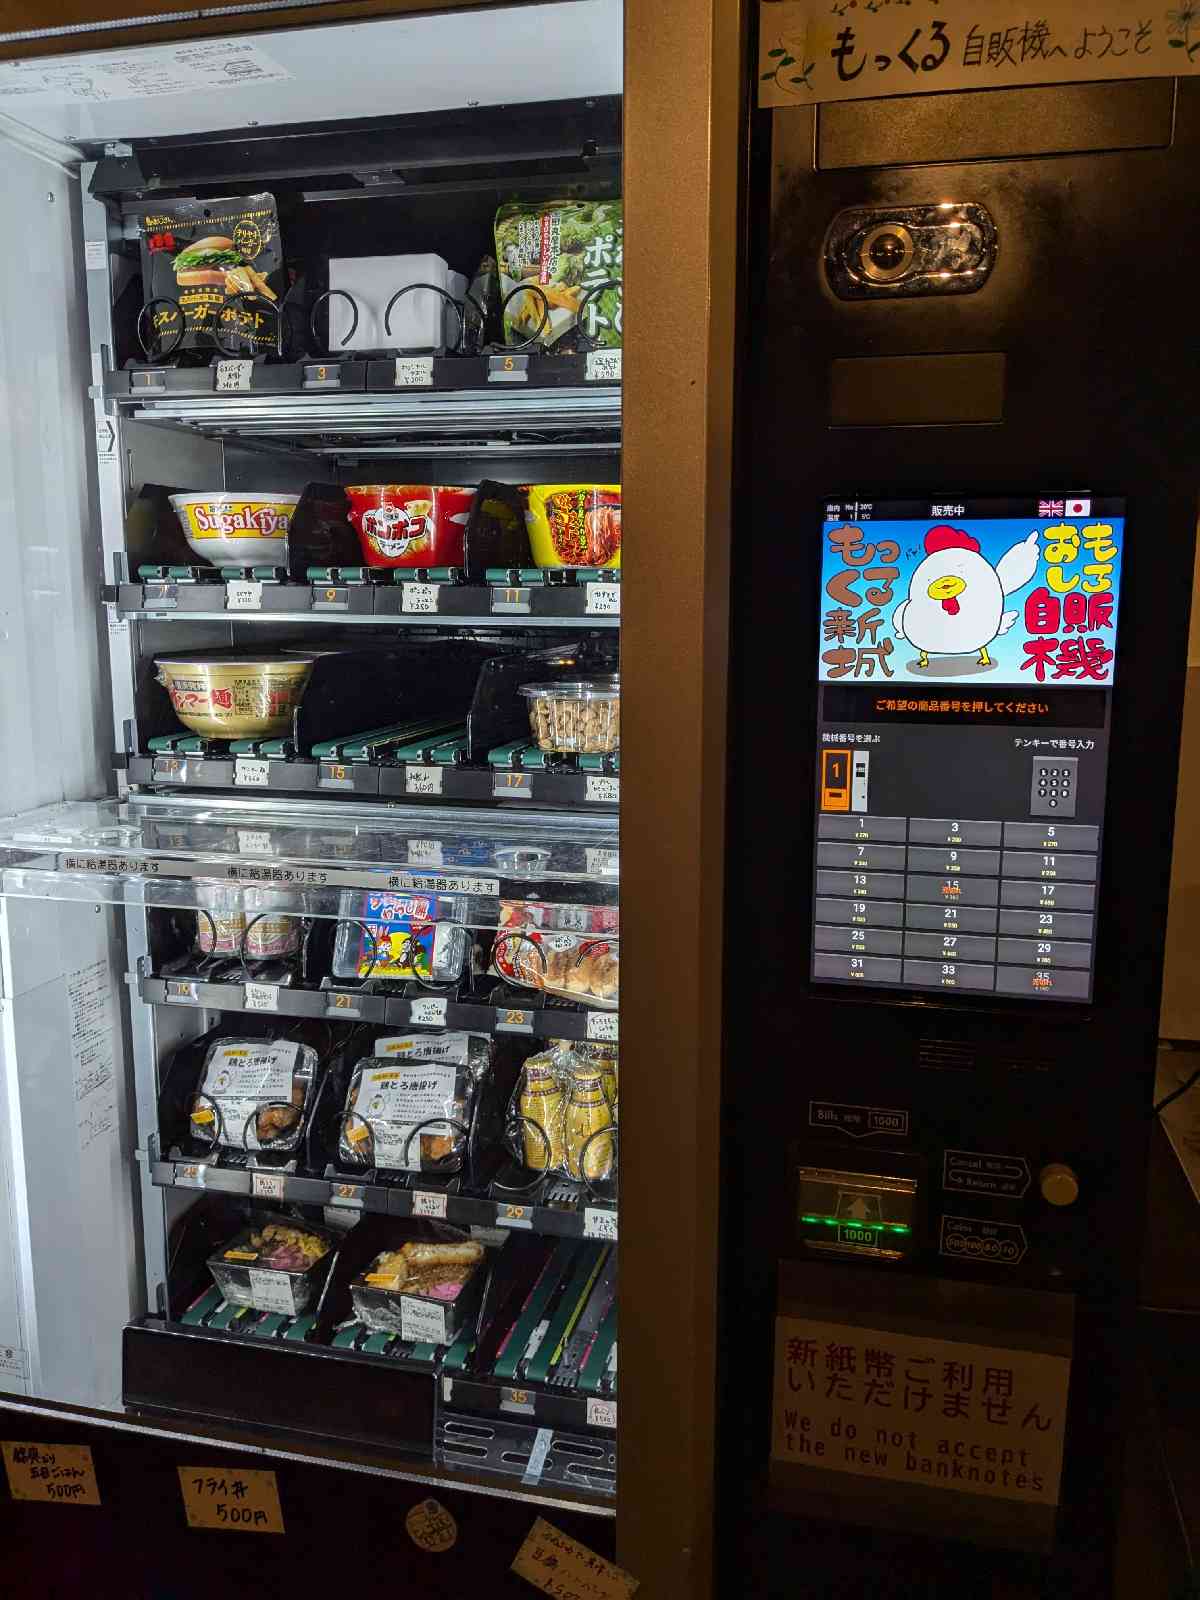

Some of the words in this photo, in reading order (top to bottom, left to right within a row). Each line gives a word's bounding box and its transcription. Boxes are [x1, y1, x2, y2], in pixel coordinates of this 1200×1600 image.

[830, 21, 952, 81] もっくる
[504, 357, 513, 371] 5
[318, 367, 326, 378] 3
[933, 505, 965, 516] 販売中
[195, 507, 289, 536] Sugakiya
[505, 590, 519, 603] 11
[876, 699, 1049, 714] ご希望の商品番号を押してください
[1014, 738, 1095, 751] テンキーで番号入力
[330, 767, 345, 779] 15
[832, 762, 840, 778] 1
[506, 774, 523, 787] 17
[859, 818, 865, 828] 1
[951, 822, 959, 832] 3
[1047, 826, 1055, 836] 5
[857, 846, 865, 856] 7
[950, 851, 957, 861] 9
[1043, 856, 1055, 866] 11
[388, 876, 496, 893] 横に給湯器あります
[853, 875, 866, 884] 13
[1042, 886, 1056, 895] 17
[853, 904, 866, 912] 19
[944, 909, 957, 918] 21
[1039, 914, 1053, 924] 23
[852, 931, 865, 940] 25
[943, 937, 957, 947] 27
[1038, 943, 1052, 953] 29
[851, 958, 864, 967] 31
[942, 964, 956, 974] 33
[335, 995, 353, 1008] 21
[506, 1012, 526, 1025] 23
[507, 1207, 524, 1219] 29
[845, 1228, 873, 1242] 1000
[786, 1337, 1014, 1397] 新紙幣ご利用
[787, 1368, 1053, 1433] いただけません
[784, 1408, 812, 1433] We
[831, 1416, 857, 1440] do
[876, 1429, 917, 1449] not
[937, 1435, 1029, 1467] accept
[785, 1434, 825, 1456] the
[844, 1445, 888, 1466] new
[905, 1451, 1044, 1490] banknotes
[217, 1503, 269, 1526] 500円
